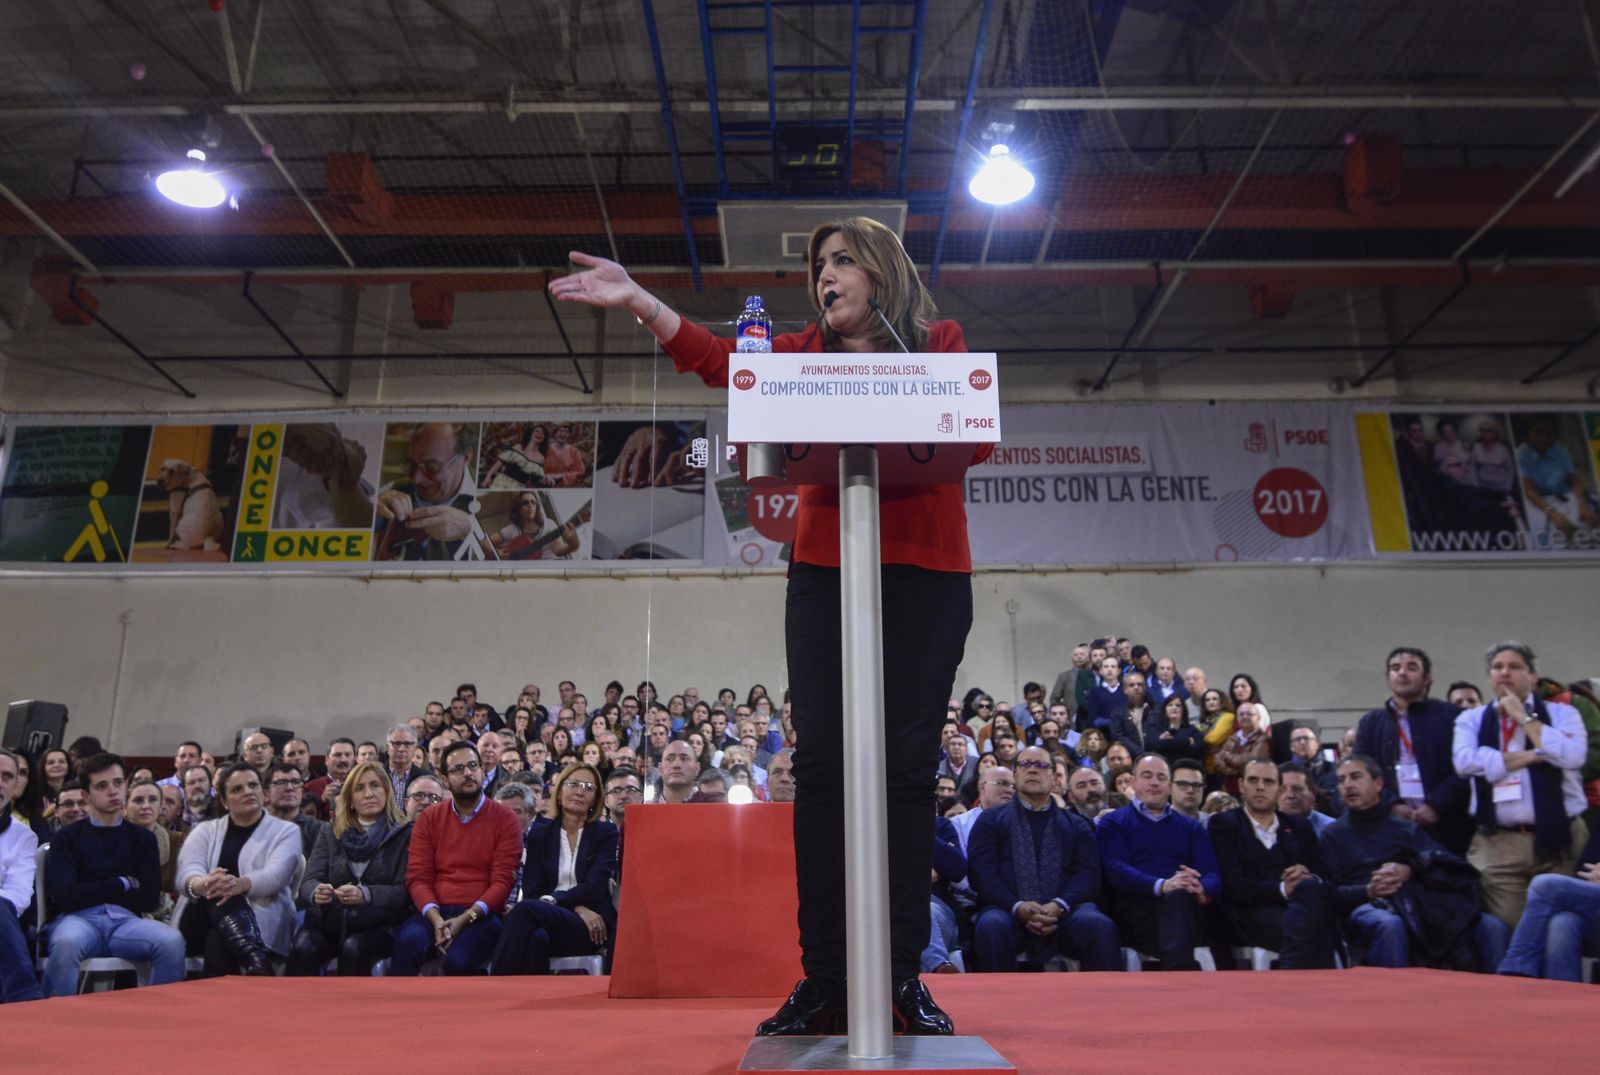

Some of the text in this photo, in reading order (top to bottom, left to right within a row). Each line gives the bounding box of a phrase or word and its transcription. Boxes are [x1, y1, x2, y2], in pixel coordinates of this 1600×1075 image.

[801, 365, 929, 375] AYUNTAMIENTOS SOCIALISTAS.
[735, 375, 754, 384] 1979
[971, 375, 990, 384] 2017
[761, 381, 965, 396] COMPROMETIDOS CON LA GENTE.
[965, 417, 995, 428] PSOE
[1285, 429, 1328, 445] PSOE
[987, 445, 1146, 466] ENTOS SOCIALISTAS.
[246, 430, 277, 526] ONCE
[964, 476, 1218, 503] ETIDOS CON LA GENTE.
[1259, 488, 1323, 515] 2017
[273, 535, 364, 557] ONCE
